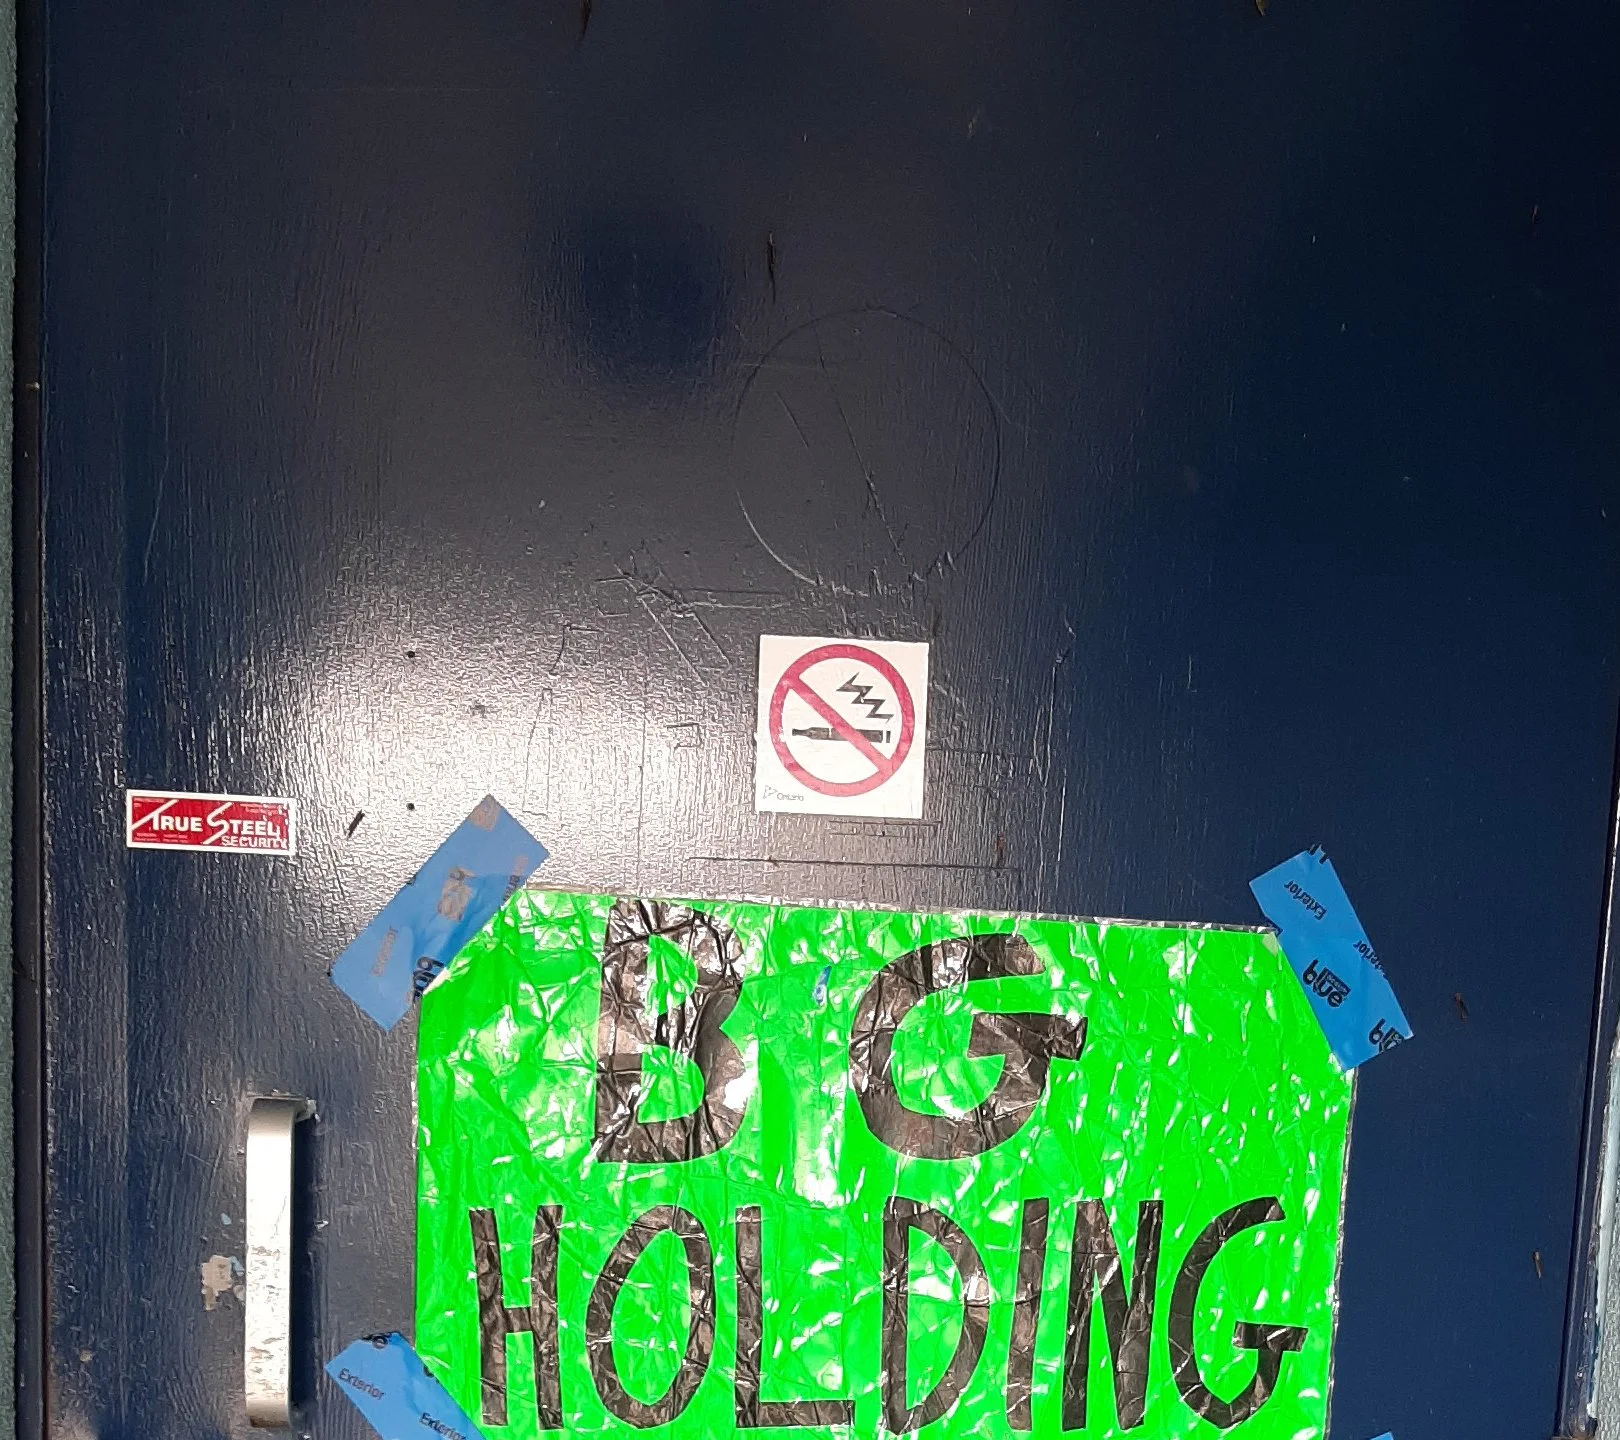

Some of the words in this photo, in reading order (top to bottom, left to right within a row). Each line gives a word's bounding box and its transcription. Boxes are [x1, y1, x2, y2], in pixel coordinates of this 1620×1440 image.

[131, 799, 203, 832] TRUE
[203, 801, 281, 845] STEEL
[221, 836, 288, 850] SECURITY
[1284, 880, 1327, 920] Exterior
[1353, 940, 1386, 976] terior
[1303, 959, 1346, 1008] blue
[468, 1196, 1308, 1434] HOLDING
[338, 1367, 385, 1400] Exterior
